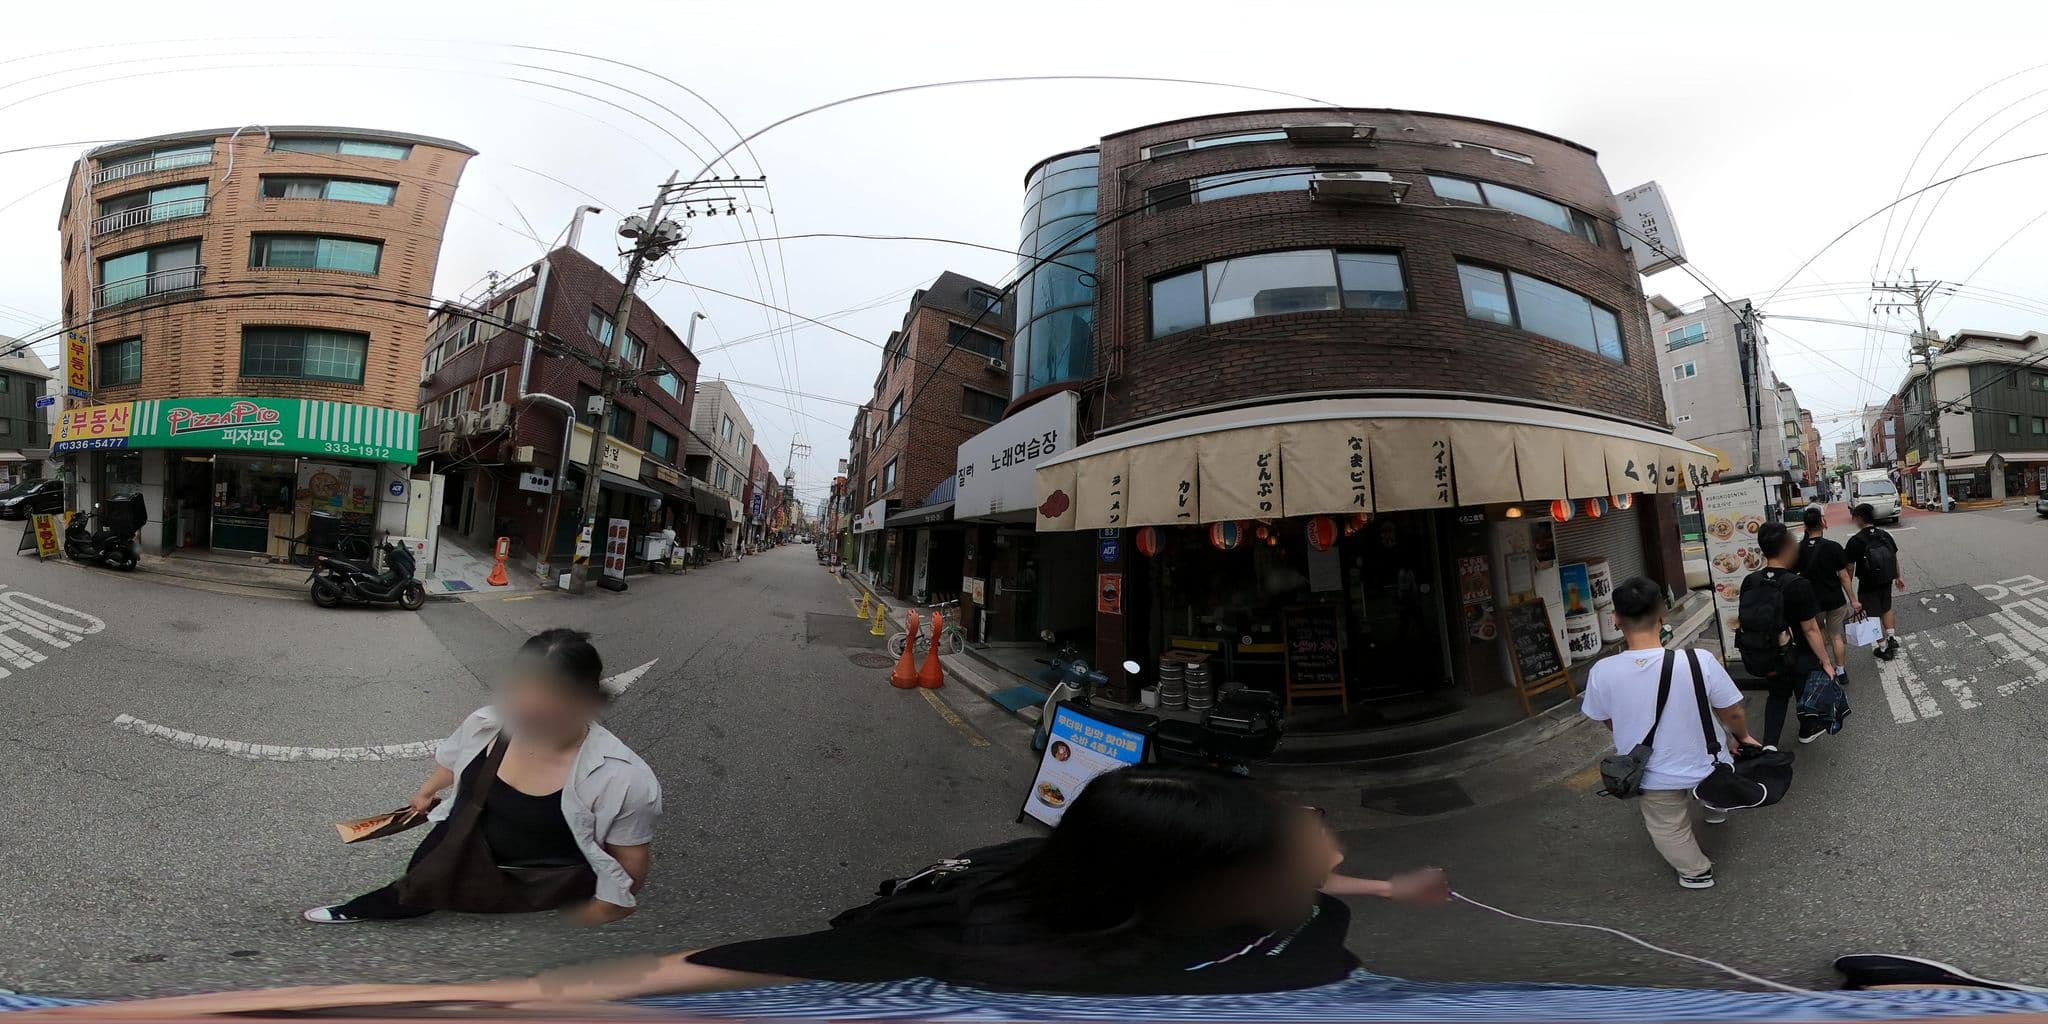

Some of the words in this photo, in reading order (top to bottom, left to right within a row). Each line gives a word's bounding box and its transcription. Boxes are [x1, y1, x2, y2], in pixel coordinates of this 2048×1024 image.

[71, 342, 85, 387] 부동산
[61, 413, 70, 439] 삼성
[72, 406, 129, 436] 부동산
[222, 429, 285, 446] 피자피오
[325, 442, 389, 459] 333-1912
[991, 430, 1058, 472] 노래연습장
[958, 463, 975, 487] 질러
[1348, 436, 1366, 508] なまビール
[1432, 439, 1449, 503] ハイボール
[1110, 475, 1121, 523] ラーメン
[1177, 480, 1191, 518] カレー
[1102, 547, 1117, 555] ADT
[1059, 716, 1082, 731] 무더위
